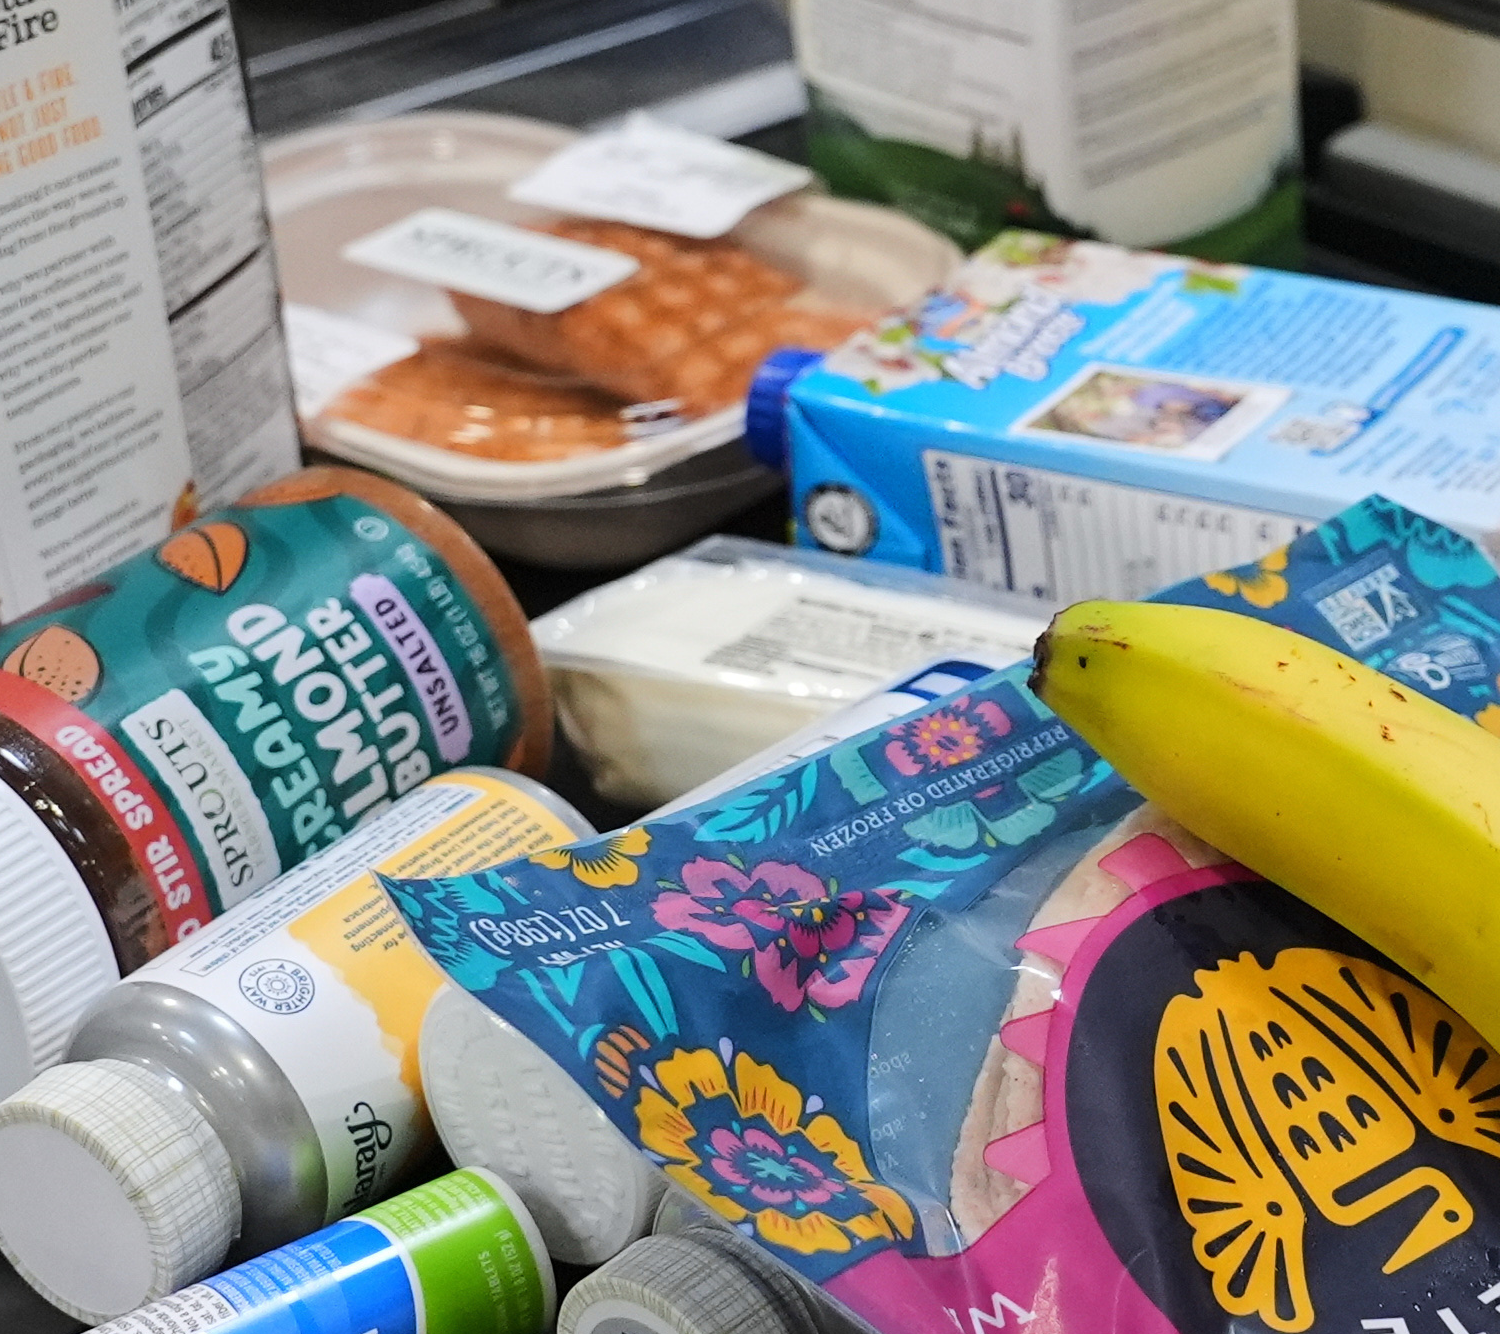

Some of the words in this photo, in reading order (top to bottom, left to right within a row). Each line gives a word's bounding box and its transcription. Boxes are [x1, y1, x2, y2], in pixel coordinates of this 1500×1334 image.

[38, 63, 75, 91] FIRE
[32, 95, 67, 128] JUST
[16, 132, 59, 168] GOOD
[62, 114, 104, 148] FOOD
[374, 597, 460, 736] UNSALTED
[227, 604, 390, 820] LMOND
[304, 595, 432, 800] BUTTER
[53, 724, 154, 832] SPREAD
[925, 723, 1071, 801] REFRIGERATED
[145, 717, 254, 888] SPROUTS
[892, 789, 927, 816] OR
[809, 805, 898, 858] FROZEN
[145, 834, 194, 918] STIR
[466, 909, 569, 957] (198g)
[567, 907, 608, 938] OZ
[241, 985, 271, 1012] WAY
[271, 966, 315, 1013] BRIGHTER
